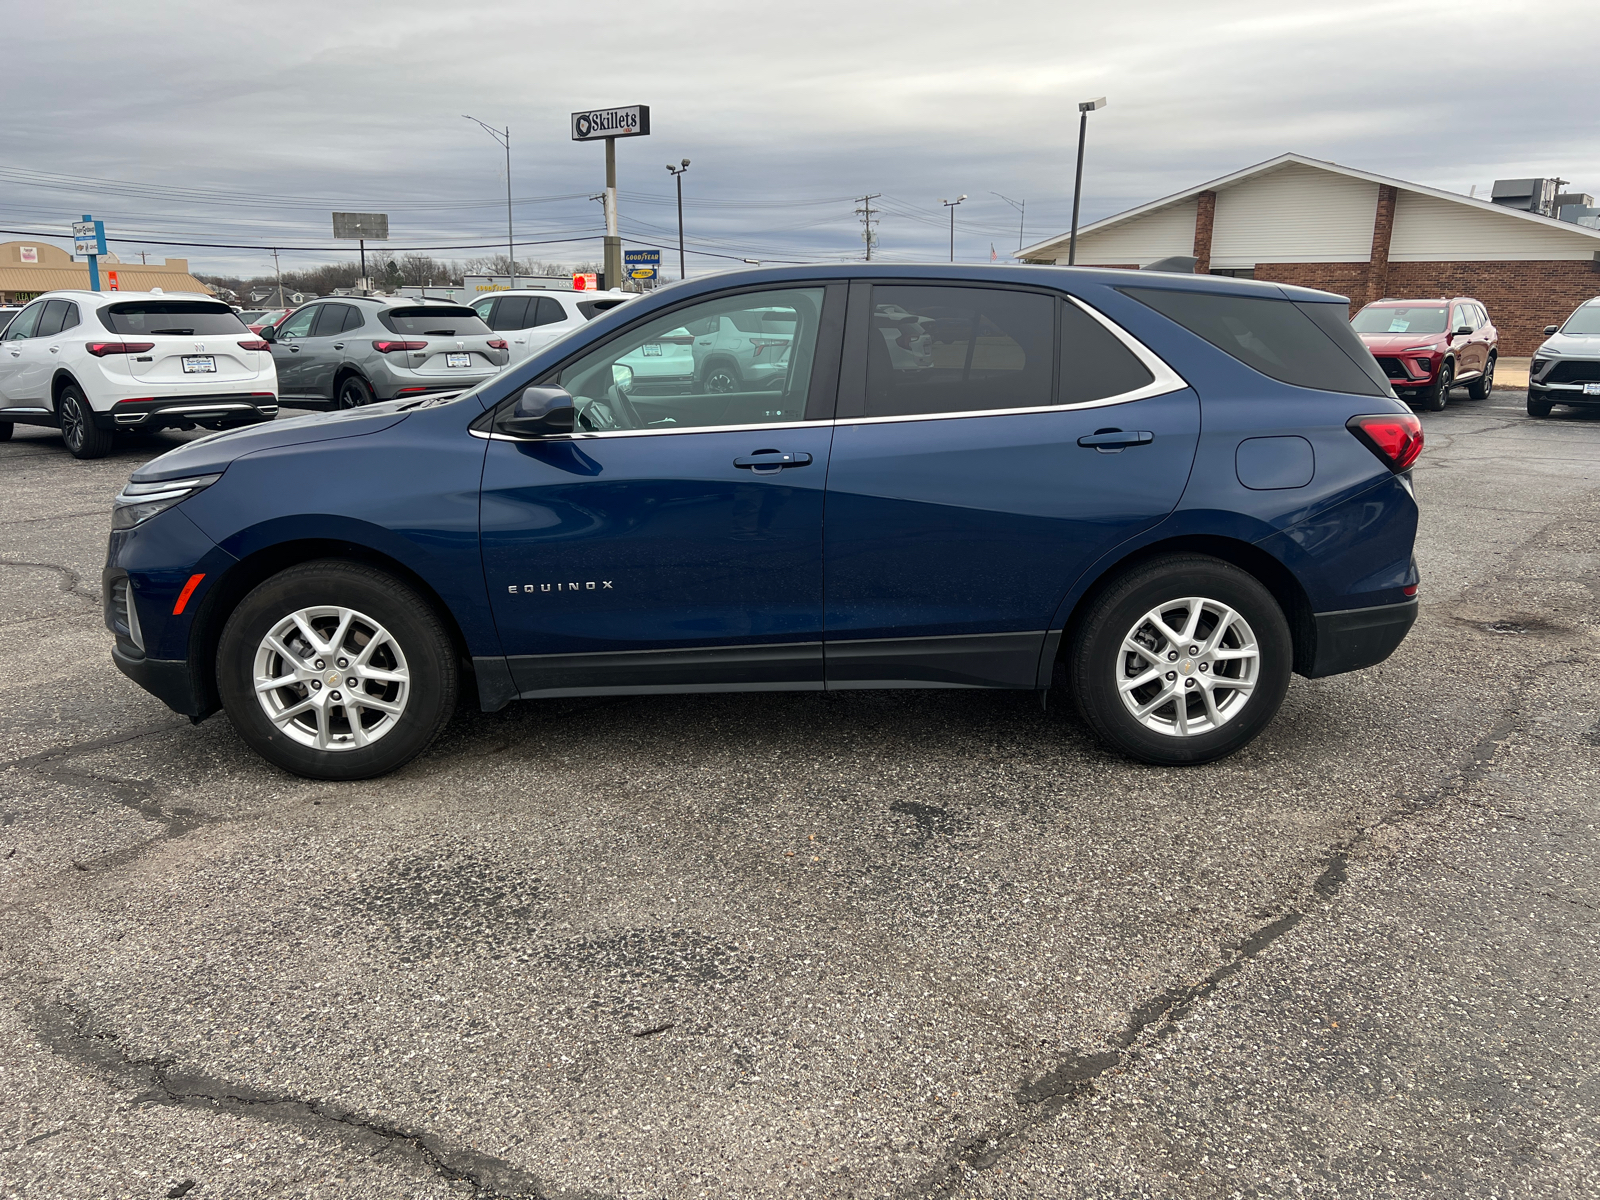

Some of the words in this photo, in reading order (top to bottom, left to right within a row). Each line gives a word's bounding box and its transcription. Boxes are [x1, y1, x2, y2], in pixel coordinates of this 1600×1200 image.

[592, 111, 637, 131] Skillets
[626, 252, 659, 261] GOODYEAR
[15, 292, 29, 301] FLEA
[508, 580, 613, 594] EQUINOX
